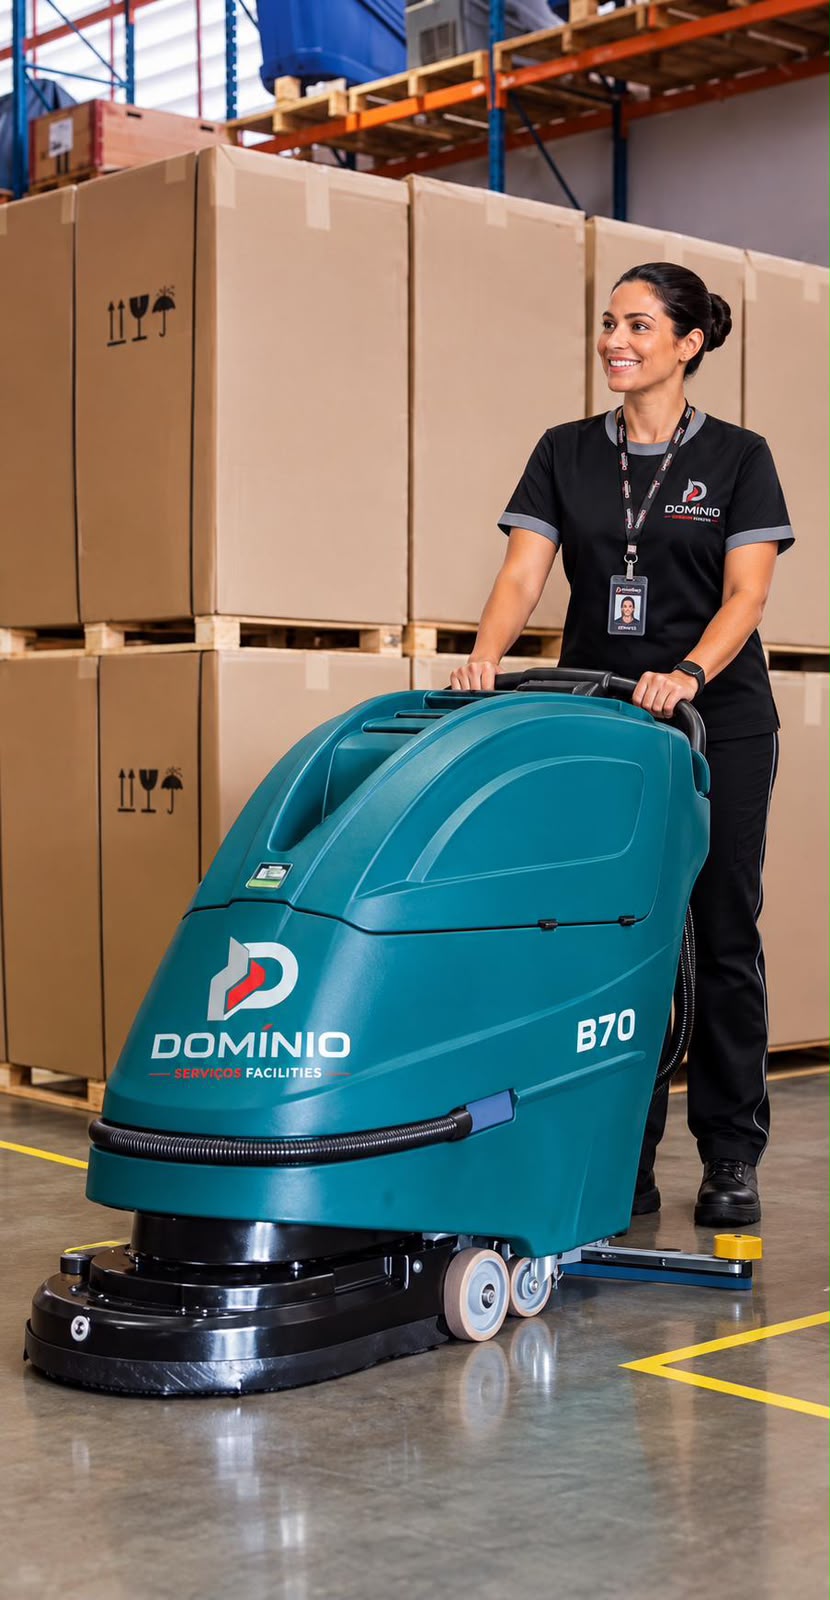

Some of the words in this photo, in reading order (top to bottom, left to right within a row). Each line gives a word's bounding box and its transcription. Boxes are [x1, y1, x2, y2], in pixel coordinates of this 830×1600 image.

[150, 1023, 351, 1060] DOMÍNIO
[576, 1008, 636, 1054] B70
[174, 1067, 243, 1081] SERVIÇOS
[245, 1066, 323, 1079] FACILITIES
